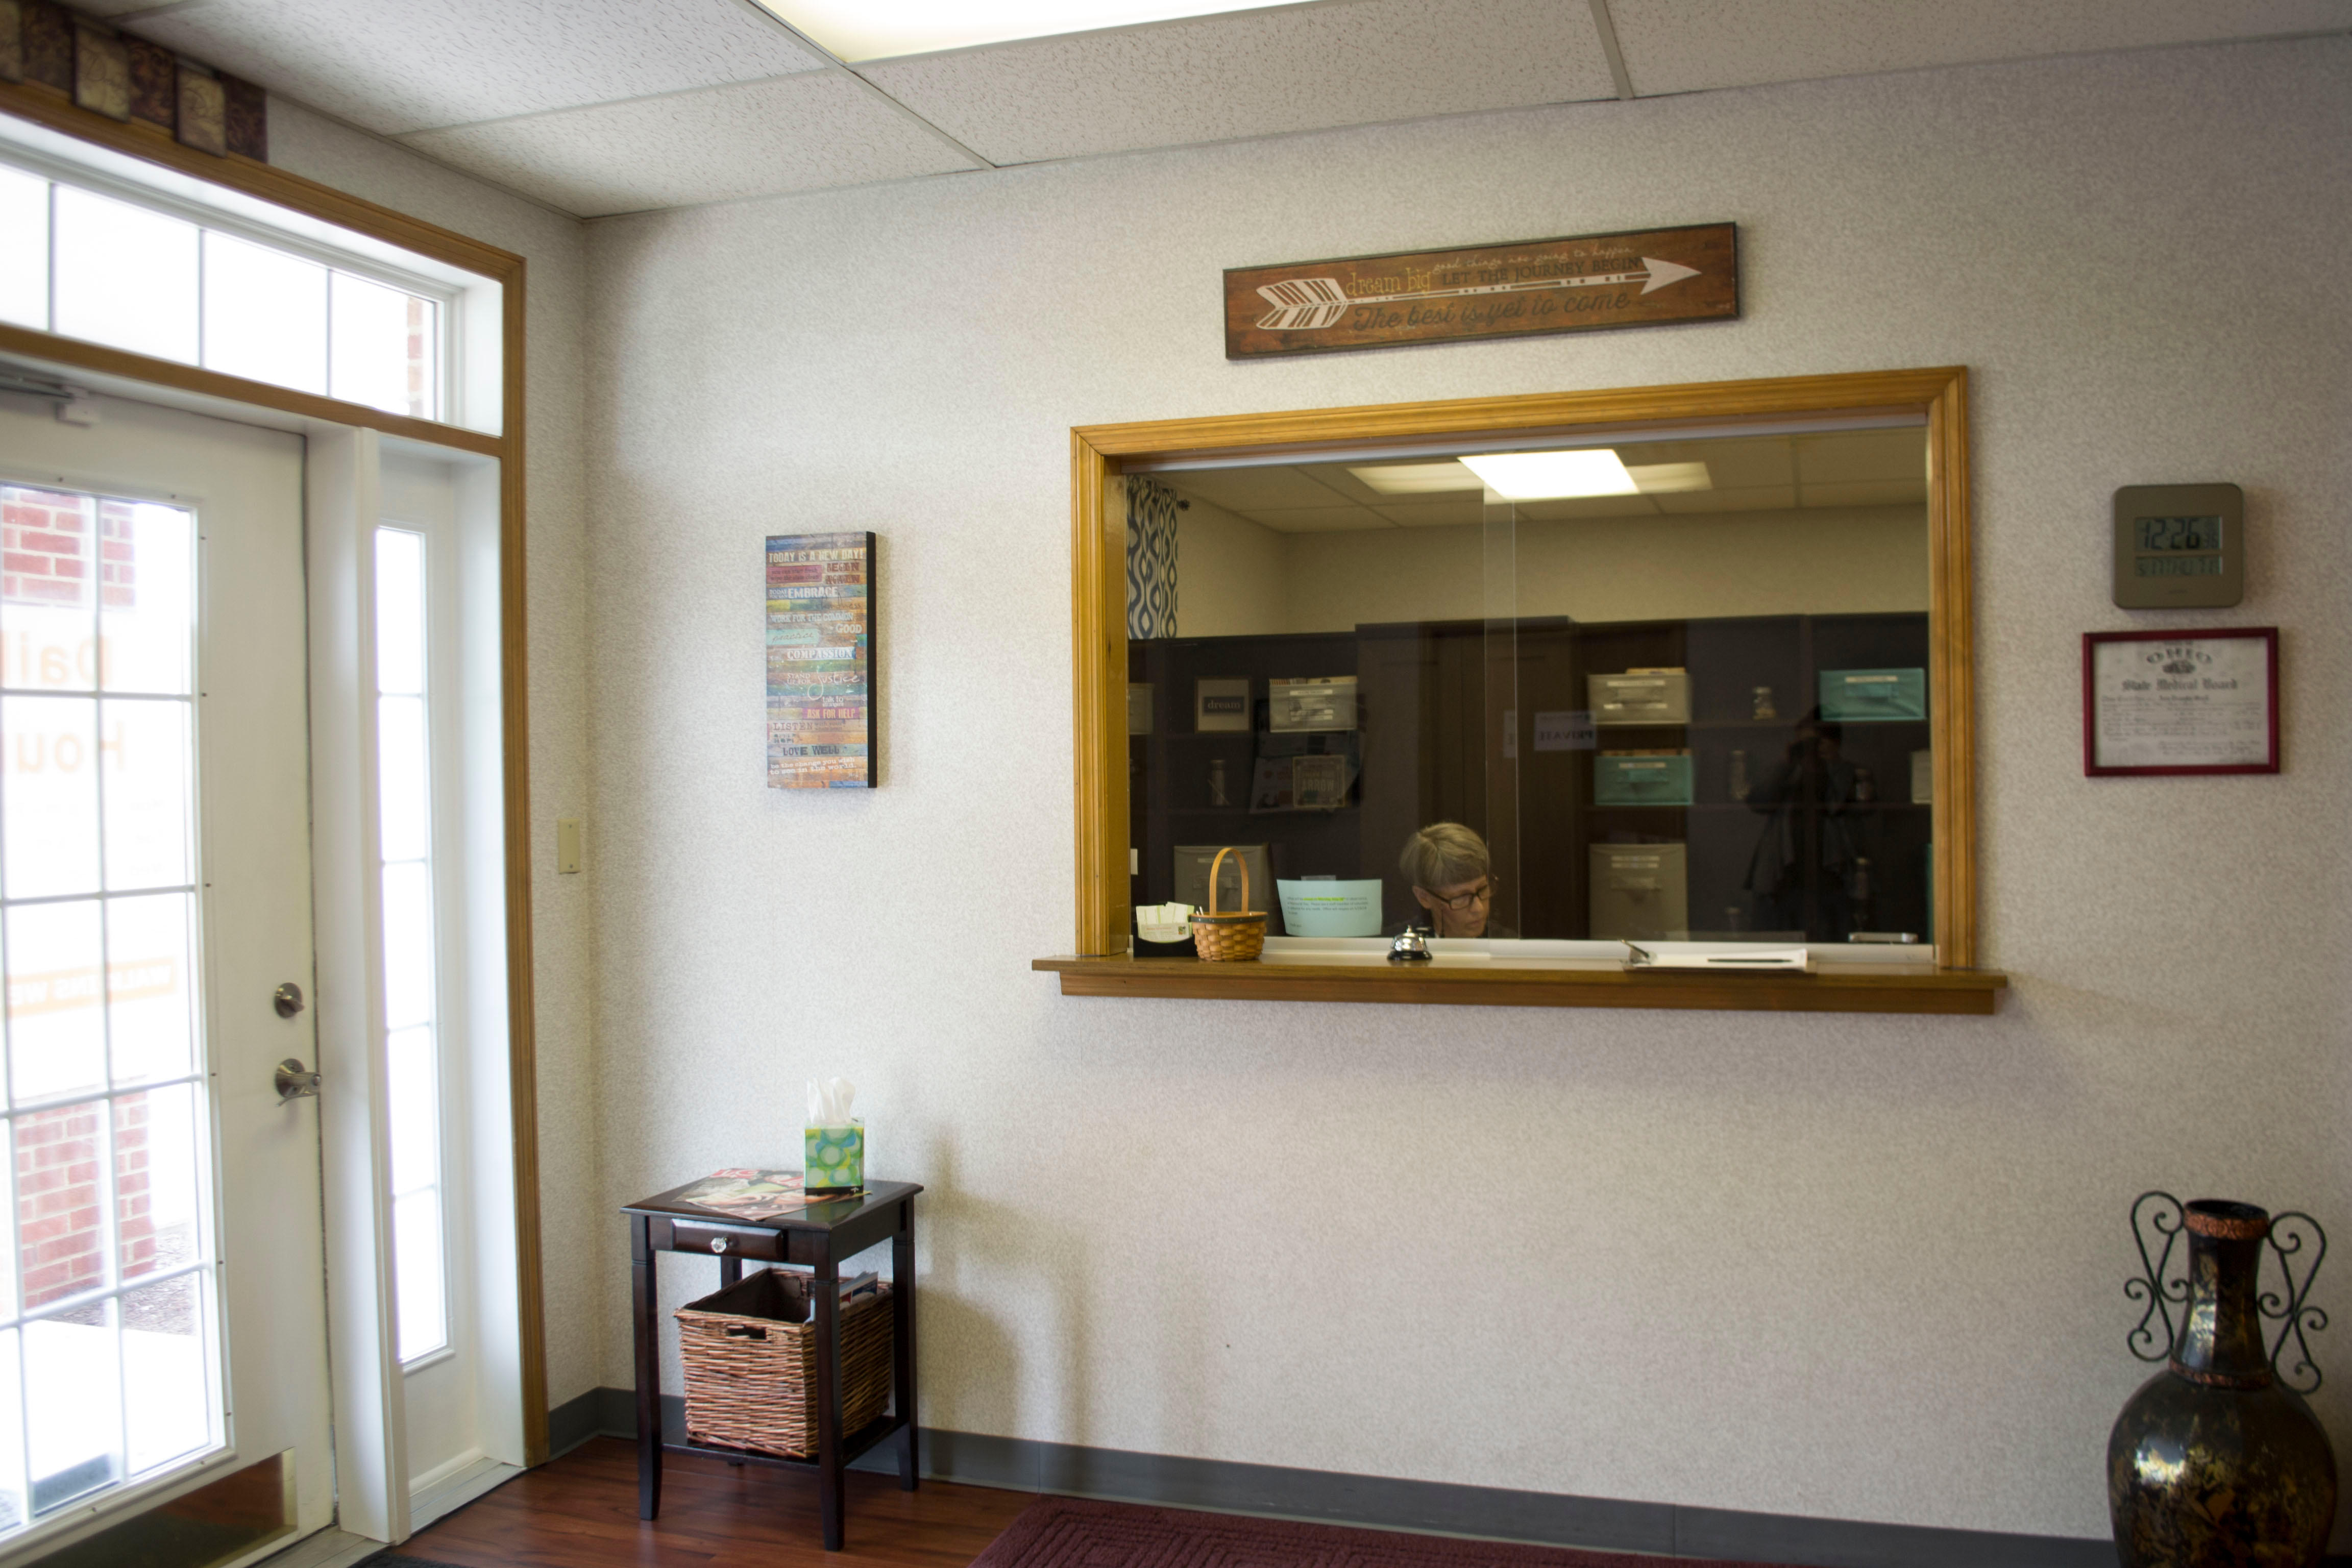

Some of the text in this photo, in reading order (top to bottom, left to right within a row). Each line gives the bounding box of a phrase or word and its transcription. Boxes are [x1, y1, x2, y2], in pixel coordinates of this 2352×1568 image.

[1442, 256, 1640, 285] LET THE JOURNEY BEGIN
[1345, 267, 1431, 297] dream big
[1353, 292, 1631, 331] The best is yet to come
[769, 549, 863, 563] TODAY IS A NEW DAY!
[827, 562, 860, 572] BEGIN
[825, 575, 861, 584] AGAIN
[788, 587, 838, 599] EMBRACE
[771, 614, 791, 623] WORK
[792, 614, 806, 622] FOR
[823, 612, 854, 621] COMMON
[836, 623, 863, 633] GOOD
[771, 632, 814, 643] practice
[787, 648, 853, 659] COMPASSION
[2147, 648, 2214, 664] OHIO
[1208, 700, 1240, 709] dream
[807, 708, 856, 719] ASK FOR HELP
[773, 722, 813, 731] LISTEN
[783, 745, 840, 756] LOVE WELL
